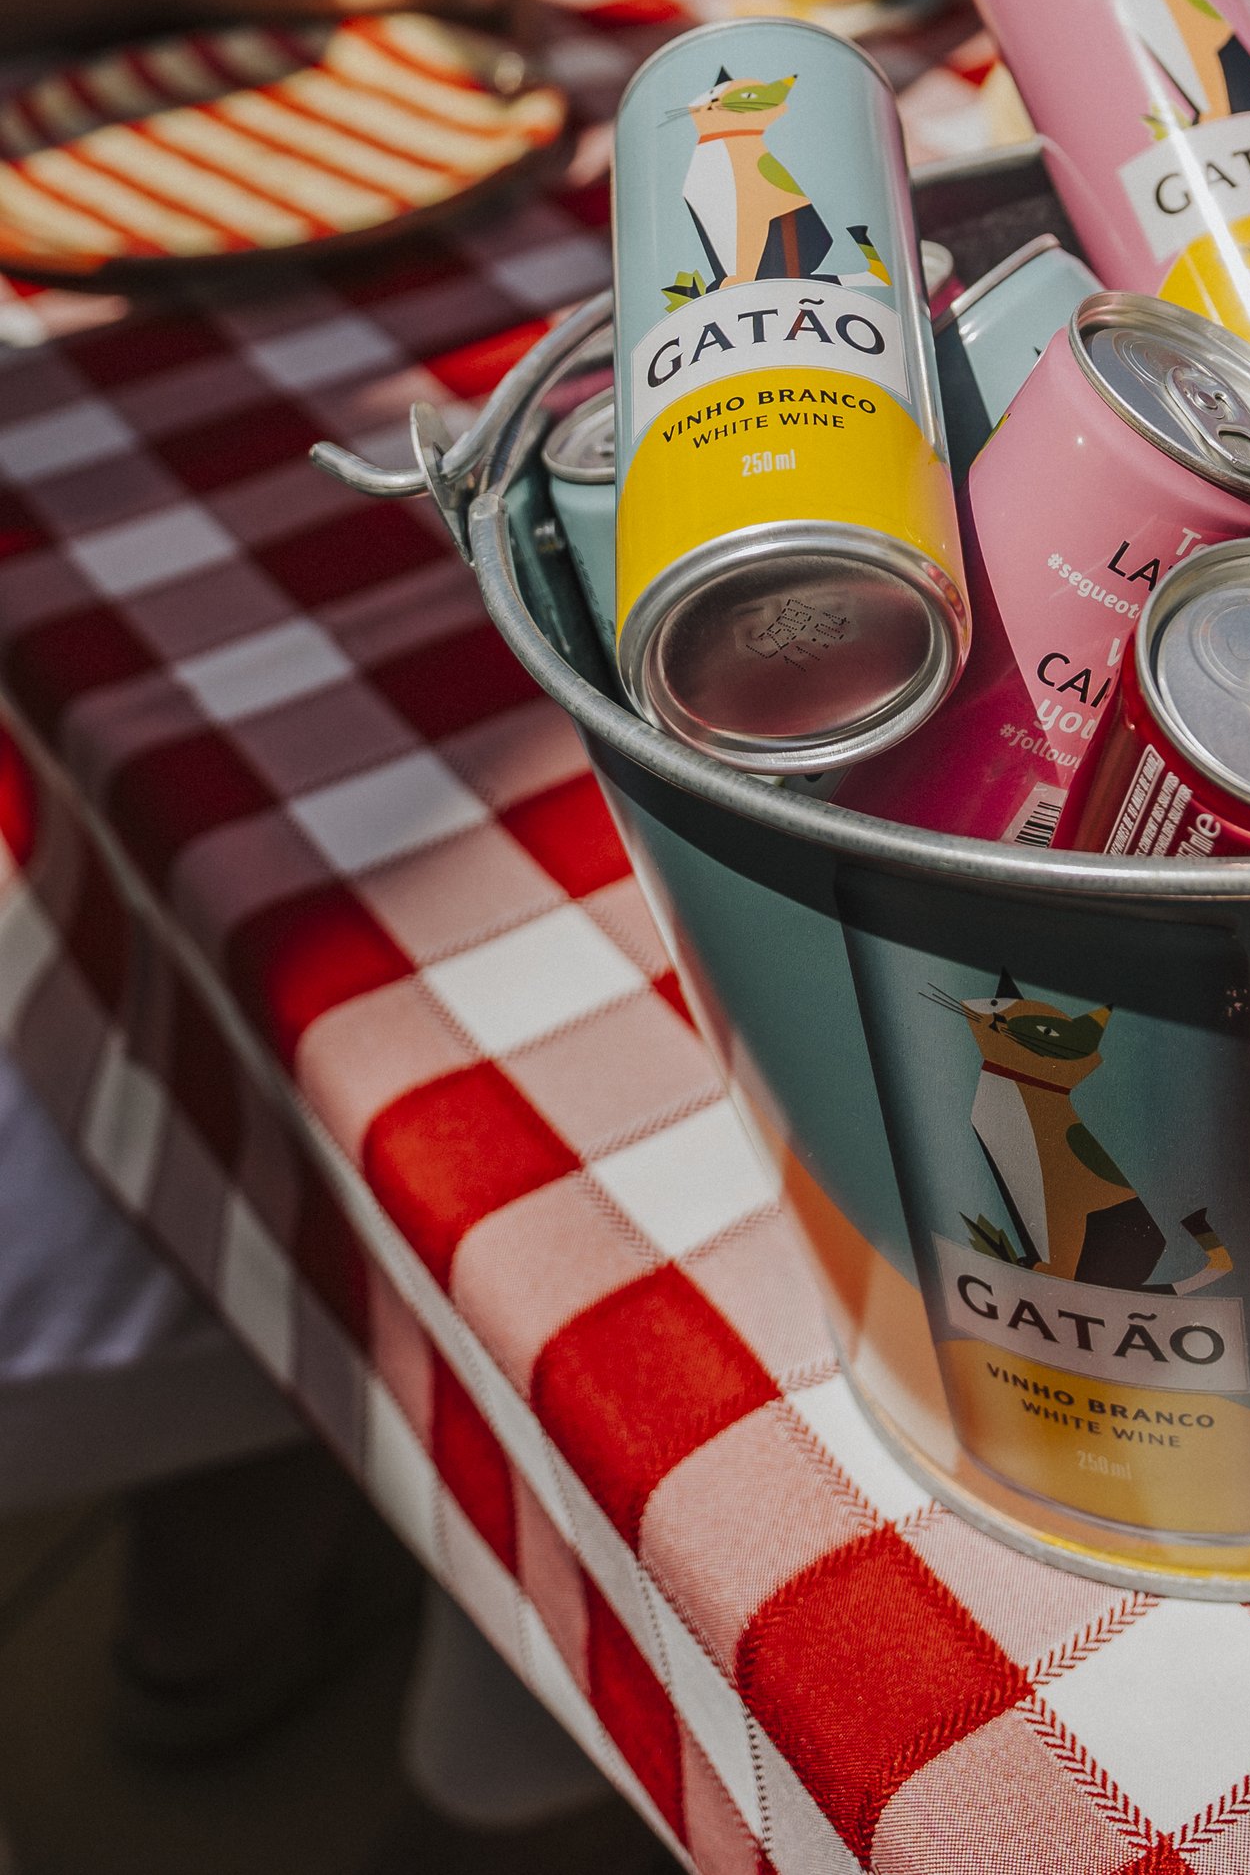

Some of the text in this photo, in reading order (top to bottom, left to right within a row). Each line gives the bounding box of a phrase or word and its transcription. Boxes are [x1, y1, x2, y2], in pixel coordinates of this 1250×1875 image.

[647, 298, 886, 388] GATÃO
[662, 389, 877, 443] VINHO BRANCO
[692, 413, 845, 449] WHITE WINE
[1047, 552, 1141, 620] #segueot
[1107, 540, 1174, 592] LA
[957, 1274, 1225, 1365] GATÃO
[986, 1362, 1215, 1429] VINHO BRANCO
[1020, 1398, 1182, 1448] WHITE WINE
